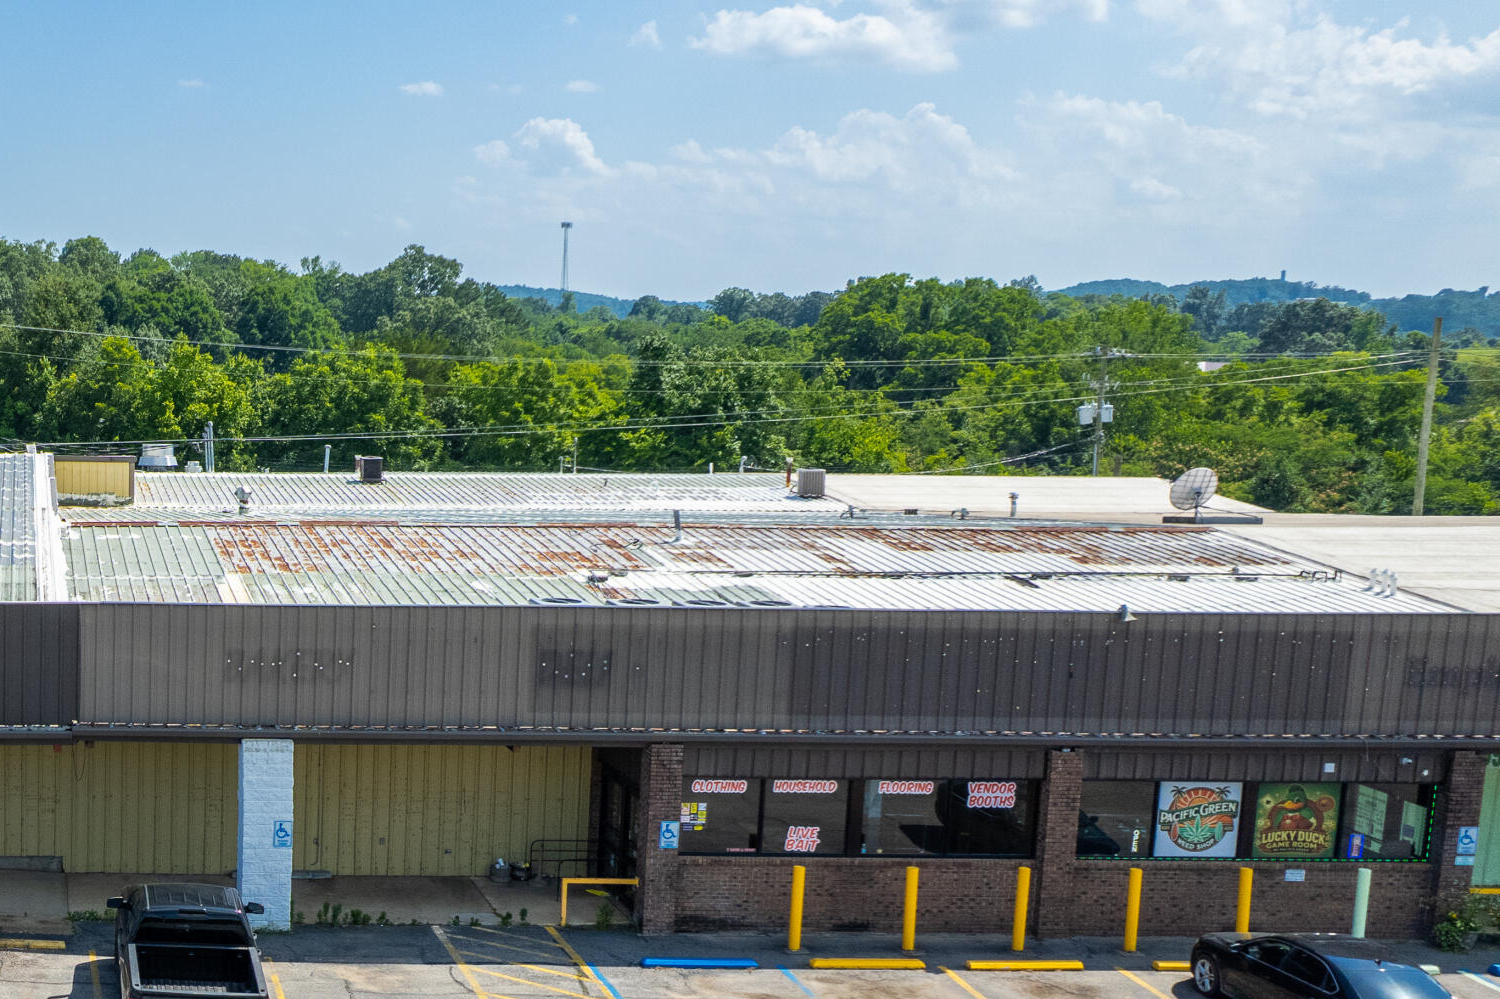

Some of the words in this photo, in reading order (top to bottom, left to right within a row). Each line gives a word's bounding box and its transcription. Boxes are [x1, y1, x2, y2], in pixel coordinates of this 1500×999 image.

[692, 780, 747, 793] CLOTHING
[773, 780, 838, 794] HOUSEHOLD
[879, 781, 934, 795] FLOORING
[967, 782, 1017, 796] VENDOR
[967, 795, 1016, 809] BOOTHS
[1160, 807, 1199, 823] PACIFIC
[1200, 802, 1238, 817] GREEN
[788, 826, 820, 840] LIVE
[1261, 830, 1297, 844] LUCKY
[1297, 830, 1326, 845] DUCK
[784, 838, 820, 852] BAIT
[1196, 838, 1216, 850] SHOP
[1291, 841, 1318, 849] ROOM
